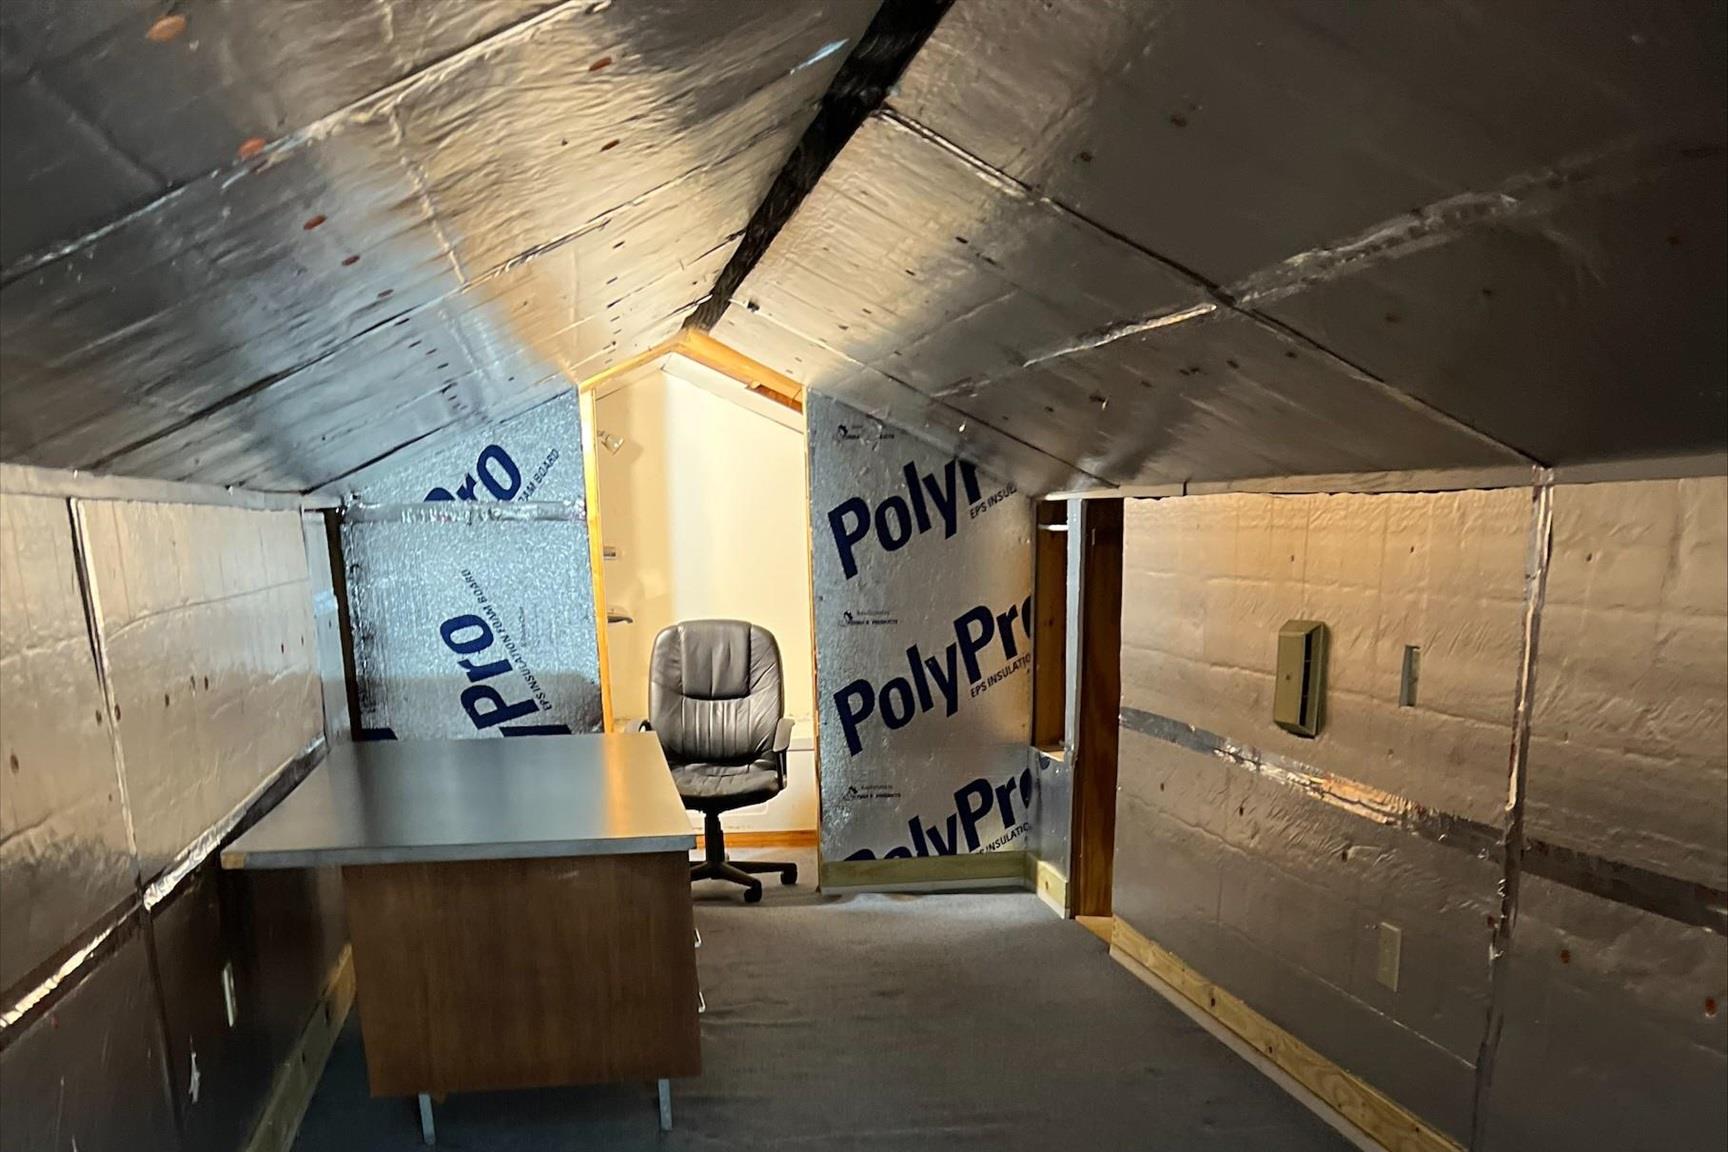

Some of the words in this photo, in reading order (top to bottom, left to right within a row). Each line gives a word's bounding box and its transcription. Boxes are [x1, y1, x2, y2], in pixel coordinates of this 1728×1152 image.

[424, 444, 521, 501] ro
[533, 449, 560, 483] BOARD
[970, 502, 987, 519] EPS
[461, 569, 488, 604] BOARD
[483, 604, 505, 635] FOAM
[501, 634, 540, 693] INSULATION
[536, 691, 552, 711] EPS
[970, 681, 987, 698] EPS
